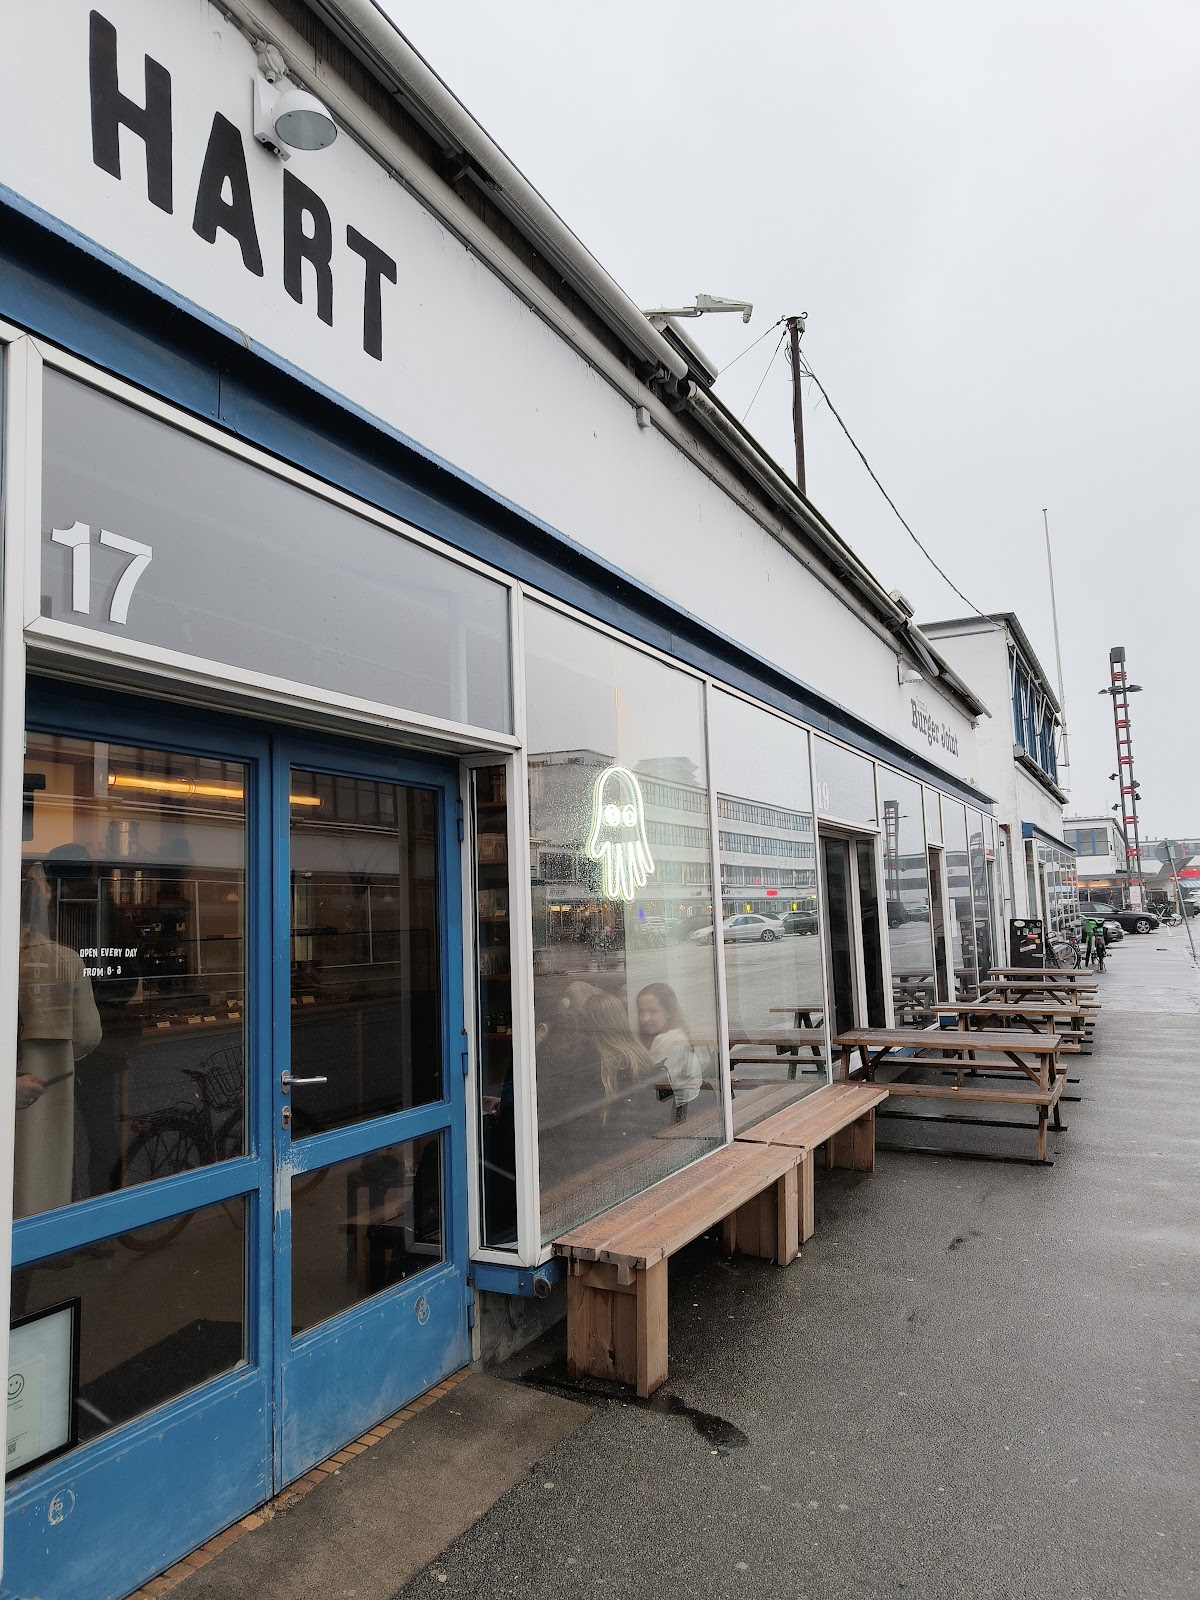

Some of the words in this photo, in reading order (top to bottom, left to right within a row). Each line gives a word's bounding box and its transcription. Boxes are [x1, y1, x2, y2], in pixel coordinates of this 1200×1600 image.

[89, 9, 397, 362] HART
[51, 520, 153, 626] 17
[910, 697, 940, 747] Burger
[80, 948, 98, 958] OPEN
[100, 948, 122, 958] EVERY
[125, 948, 138, 958] DAY
[83, 967, 104, 978] FROM
